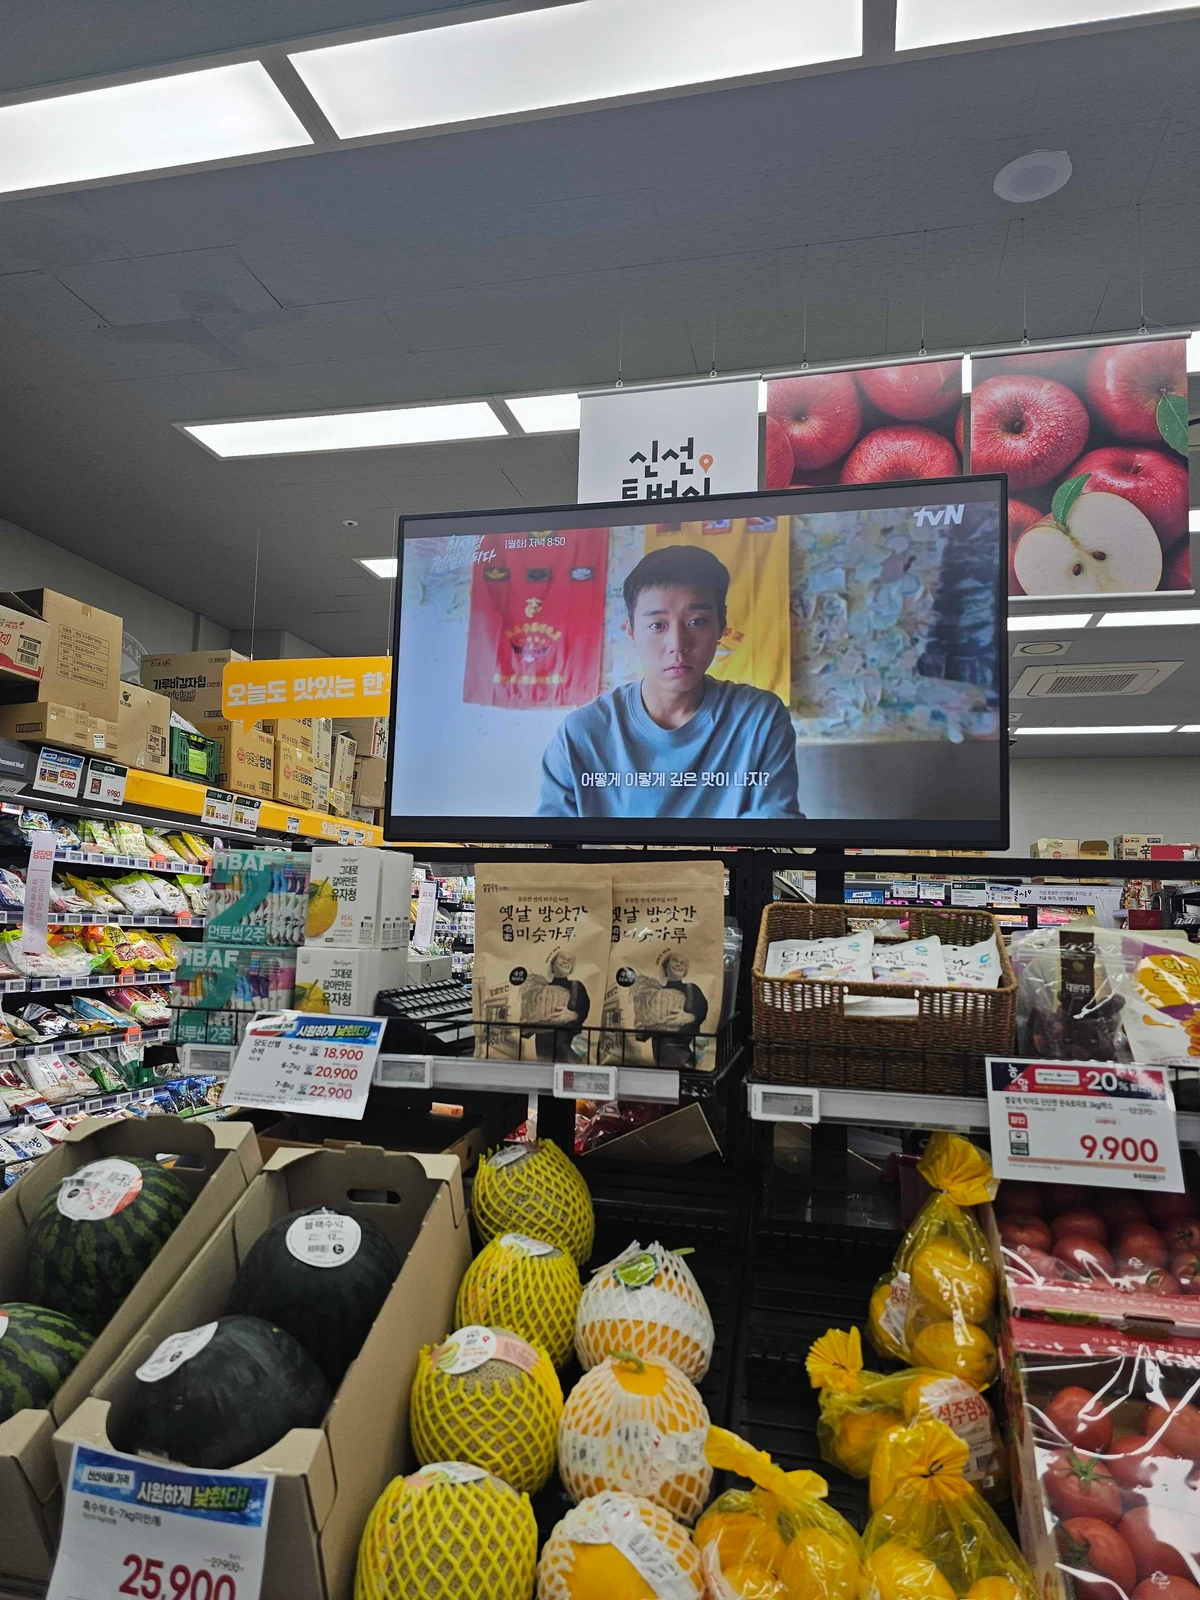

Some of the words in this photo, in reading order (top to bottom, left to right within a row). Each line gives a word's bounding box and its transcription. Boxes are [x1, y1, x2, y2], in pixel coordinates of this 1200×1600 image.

[629, 437, 694, 479] 신선
[913, 504, 964, 527] tvN
[529, 537, 546, 548] 저녁
[547, 536, 566, 547] 8:50
[153, 674, 206, 690] 가루비감자칩
[226, 679, 287, 707] 오늘도
[293, 674, 355, 701] 맛있는
[60, 780, 76, 790] 4,980
[581, 772, 621, 787] 어떻게
[625, 772, 665, 787] 이렇게
[669, 772, 698, 787] 깊은
[701, 772, 729, 787] 맛이
[734, 772, 770, 787] 나지?
[212, 852, 272, 872] HBAF
[339, 865, 359, 875] 그대로
[332, 876, 358, 886] 갈아만든
[331, 888, 357, 902] 유자청
[500, 905, 532, 923] 옛날
[538, 904, 589, 924] 방앗간
[612, 905, 640, 924] 옛날
[646, 904, 697, 924] 방앗간
[516, 926, 577, 944] 미숫가루
[178, 949, 239, 968] HBAF
[330, 968, 353, 979] 그대로
[322, 980, 353, 991] 갈아만든
[322, 992, 352, 1007] 유자청
[296, 1025, 336, 1038] 시원하게
[288, 1043, 308, 1053] 5-6kg
[324, 1047, 364, 1062] 18,900
[281, 1061, 301, 1071] 6-7kg
[315, 1065, 358, 1081] 20,900
[275, 1080, 295, 1090] 7-8kg
[308, 1085, 353, 1101] 22,900
[87, 1470, 115, 1484] 신선식품
[116, 1472, 130, 1485] 가격
[137, 1481, 191, 1504] 시원하게
[119, 1553, 236, 1600] 25,900
